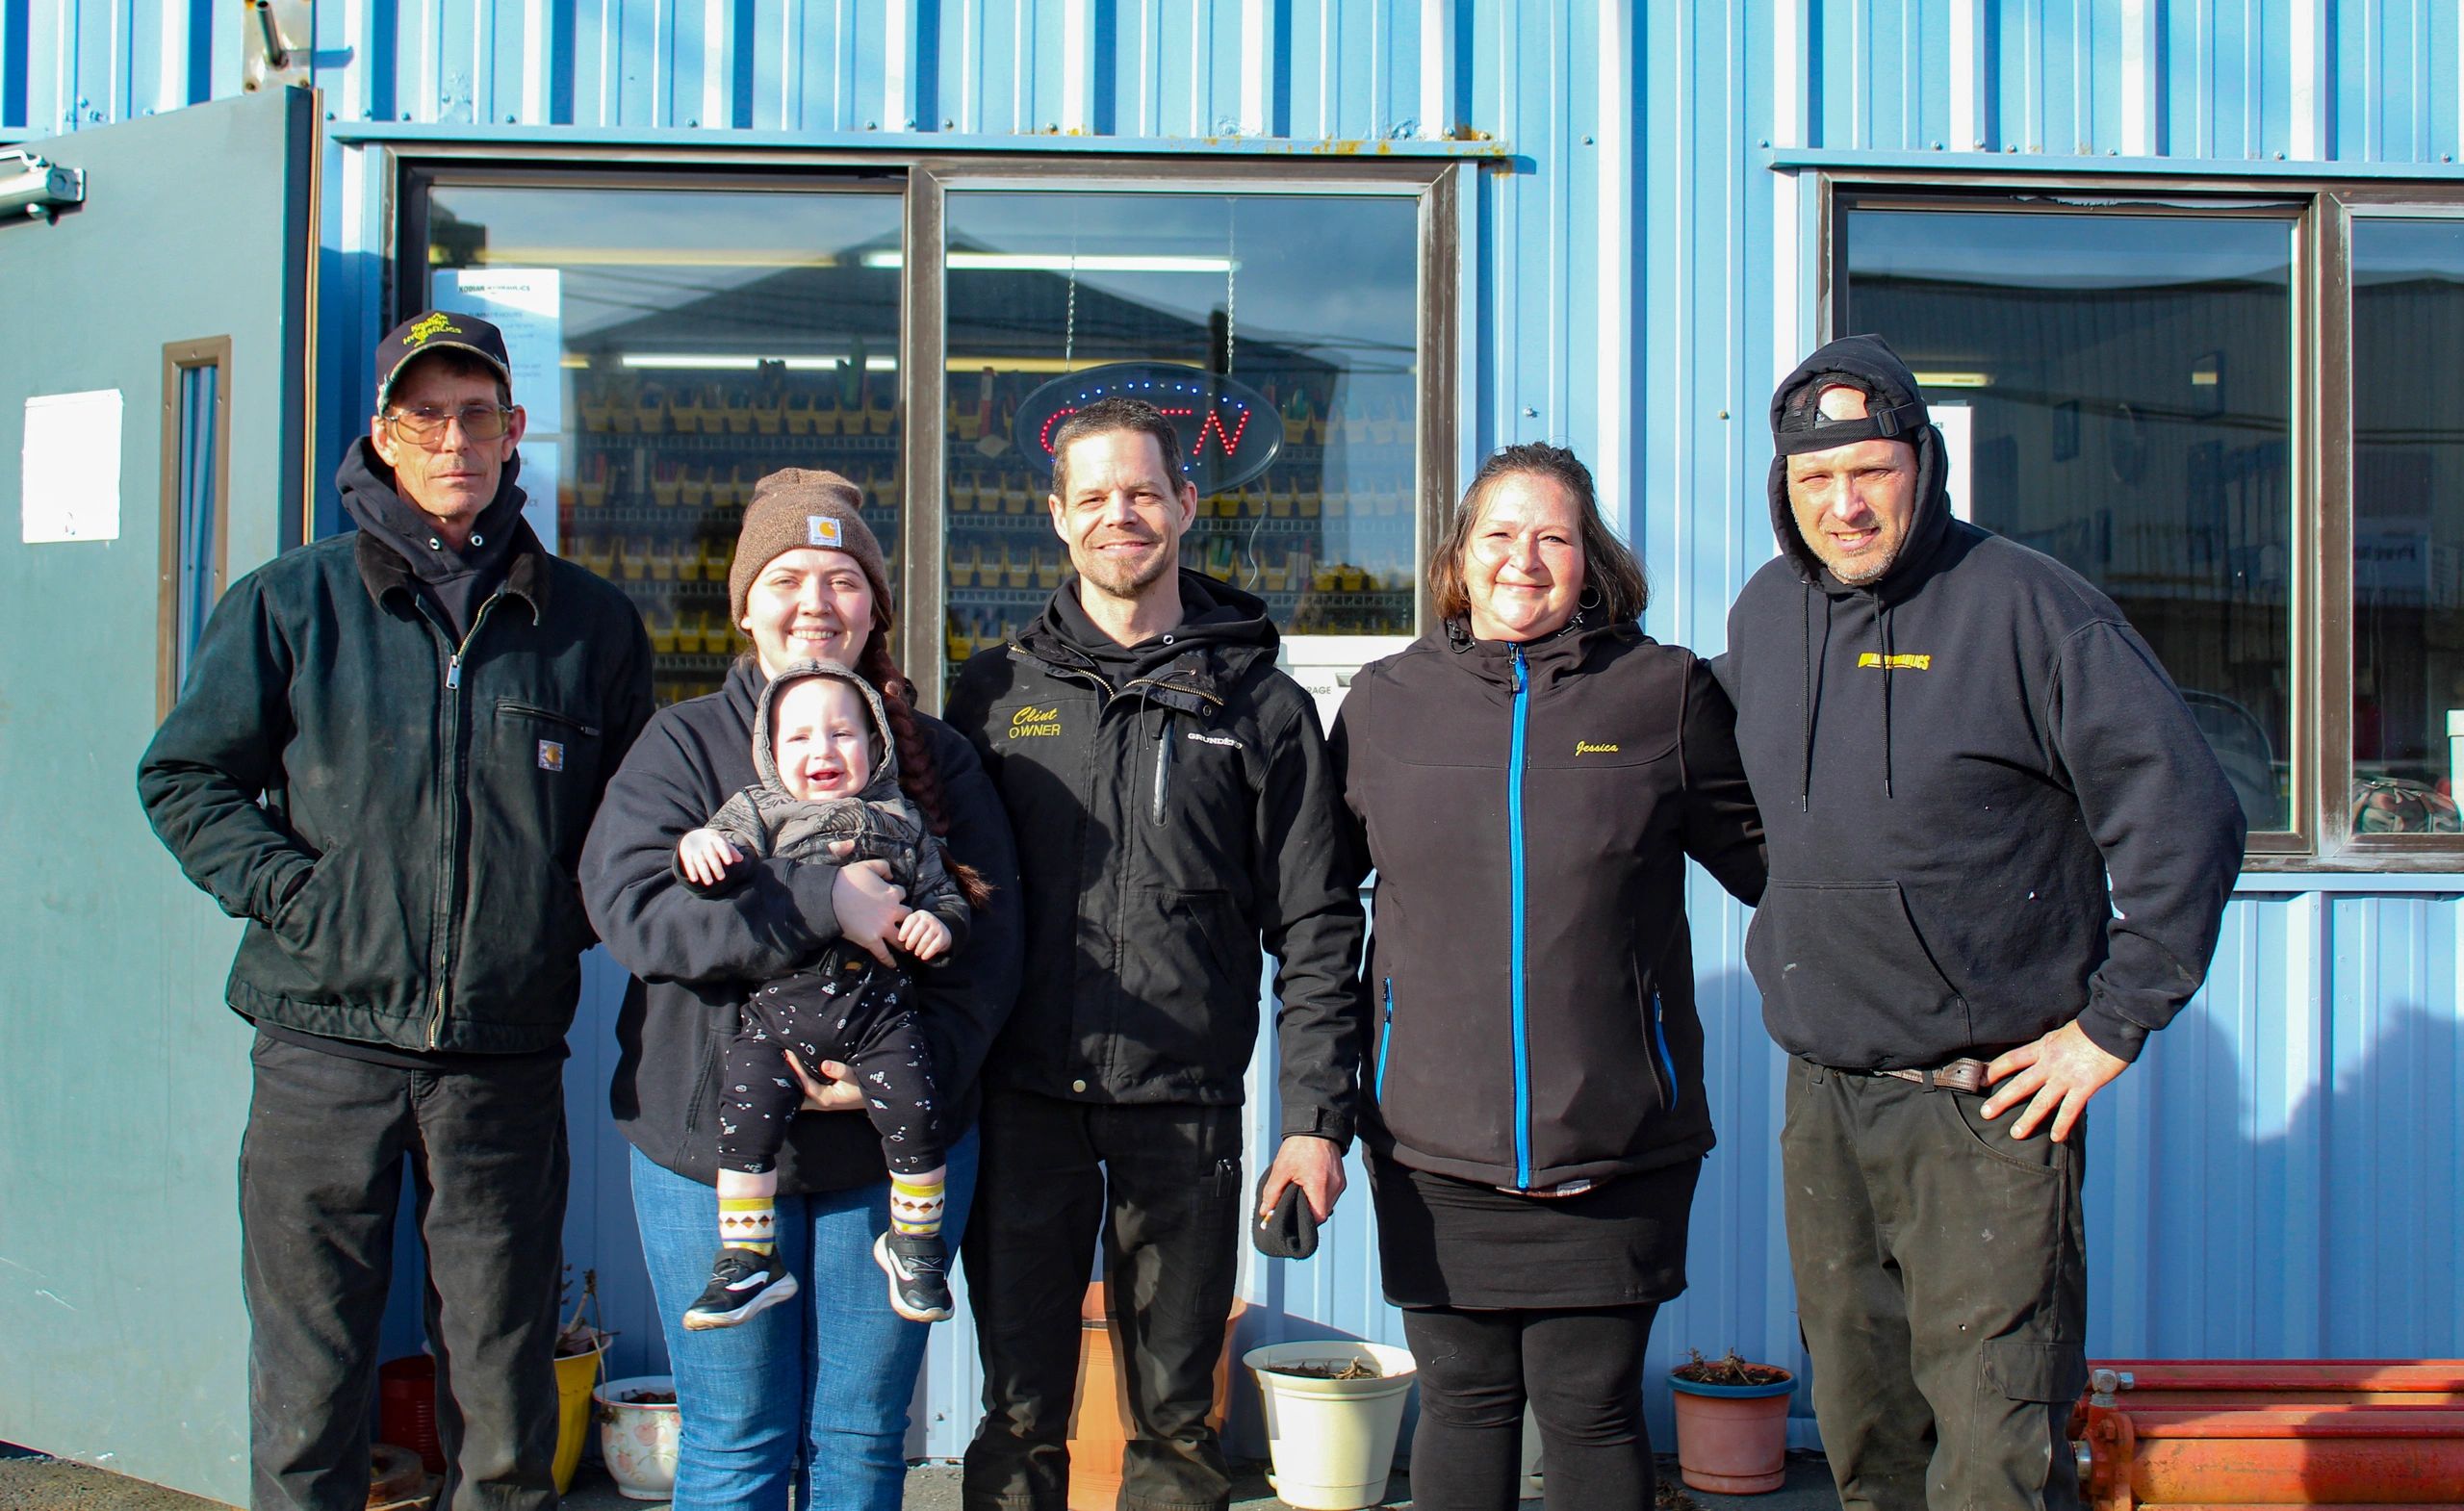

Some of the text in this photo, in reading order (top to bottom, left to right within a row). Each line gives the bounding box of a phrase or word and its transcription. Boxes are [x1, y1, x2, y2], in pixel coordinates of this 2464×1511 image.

[1013, 706, 1058, 726] Clint
[1009, 723, 1062, 739] OWNER
[1575, 740, 1619, 756] Jessica
